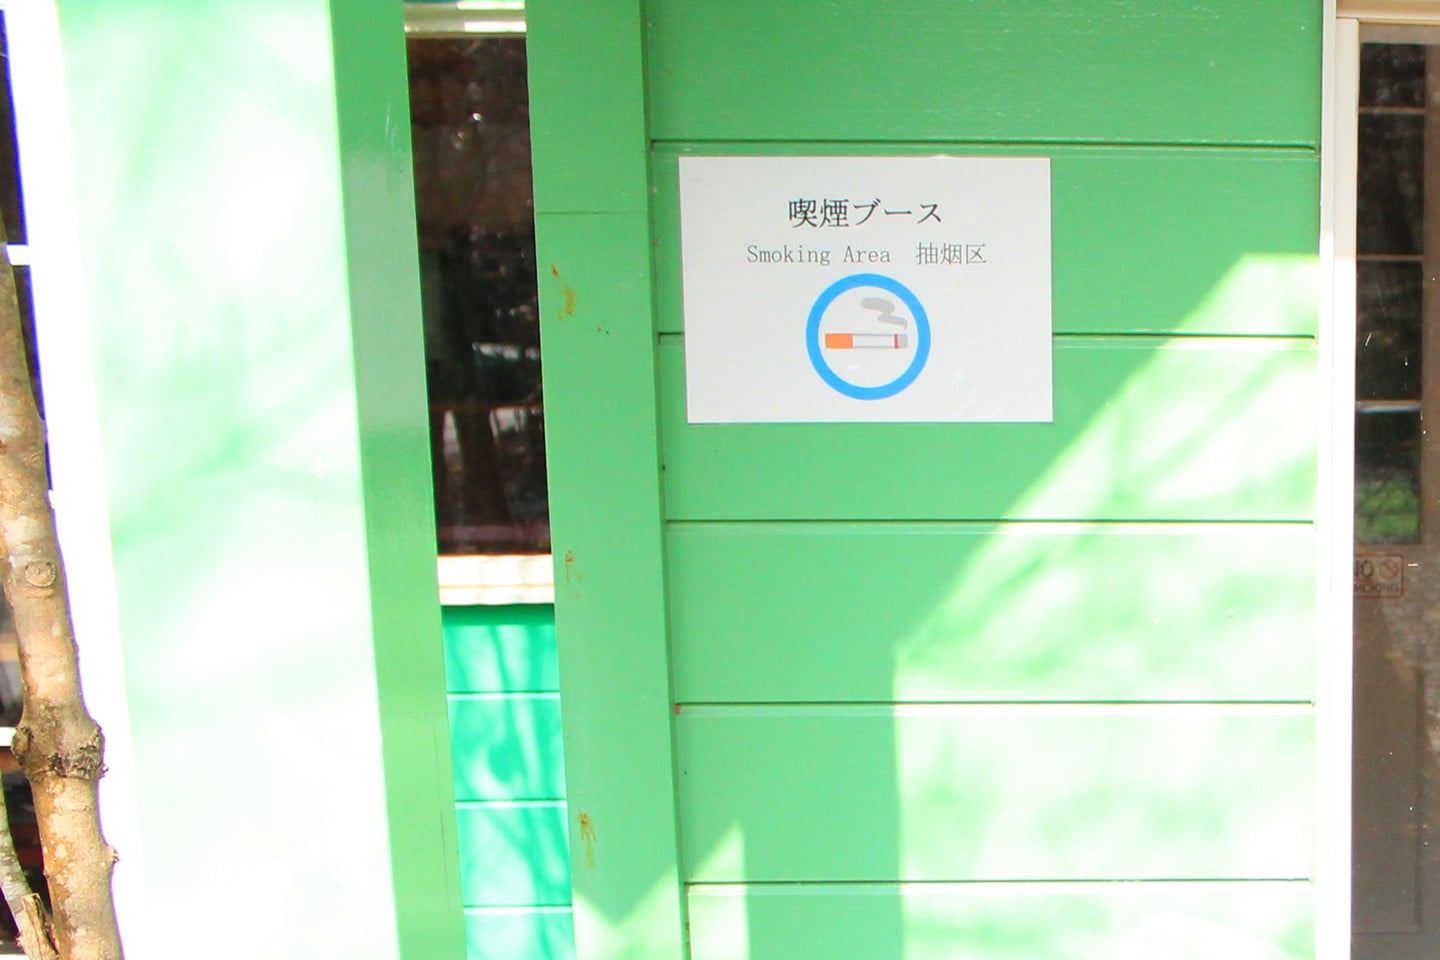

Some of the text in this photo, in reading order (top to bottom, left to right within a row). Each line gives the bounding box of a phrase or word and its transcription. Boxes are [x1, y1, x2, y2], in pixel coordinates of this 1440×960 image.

[788, 197, 942, 229] 喫煙ブース
[747, 241, 987, 266] Smoking Area 抽烟区
